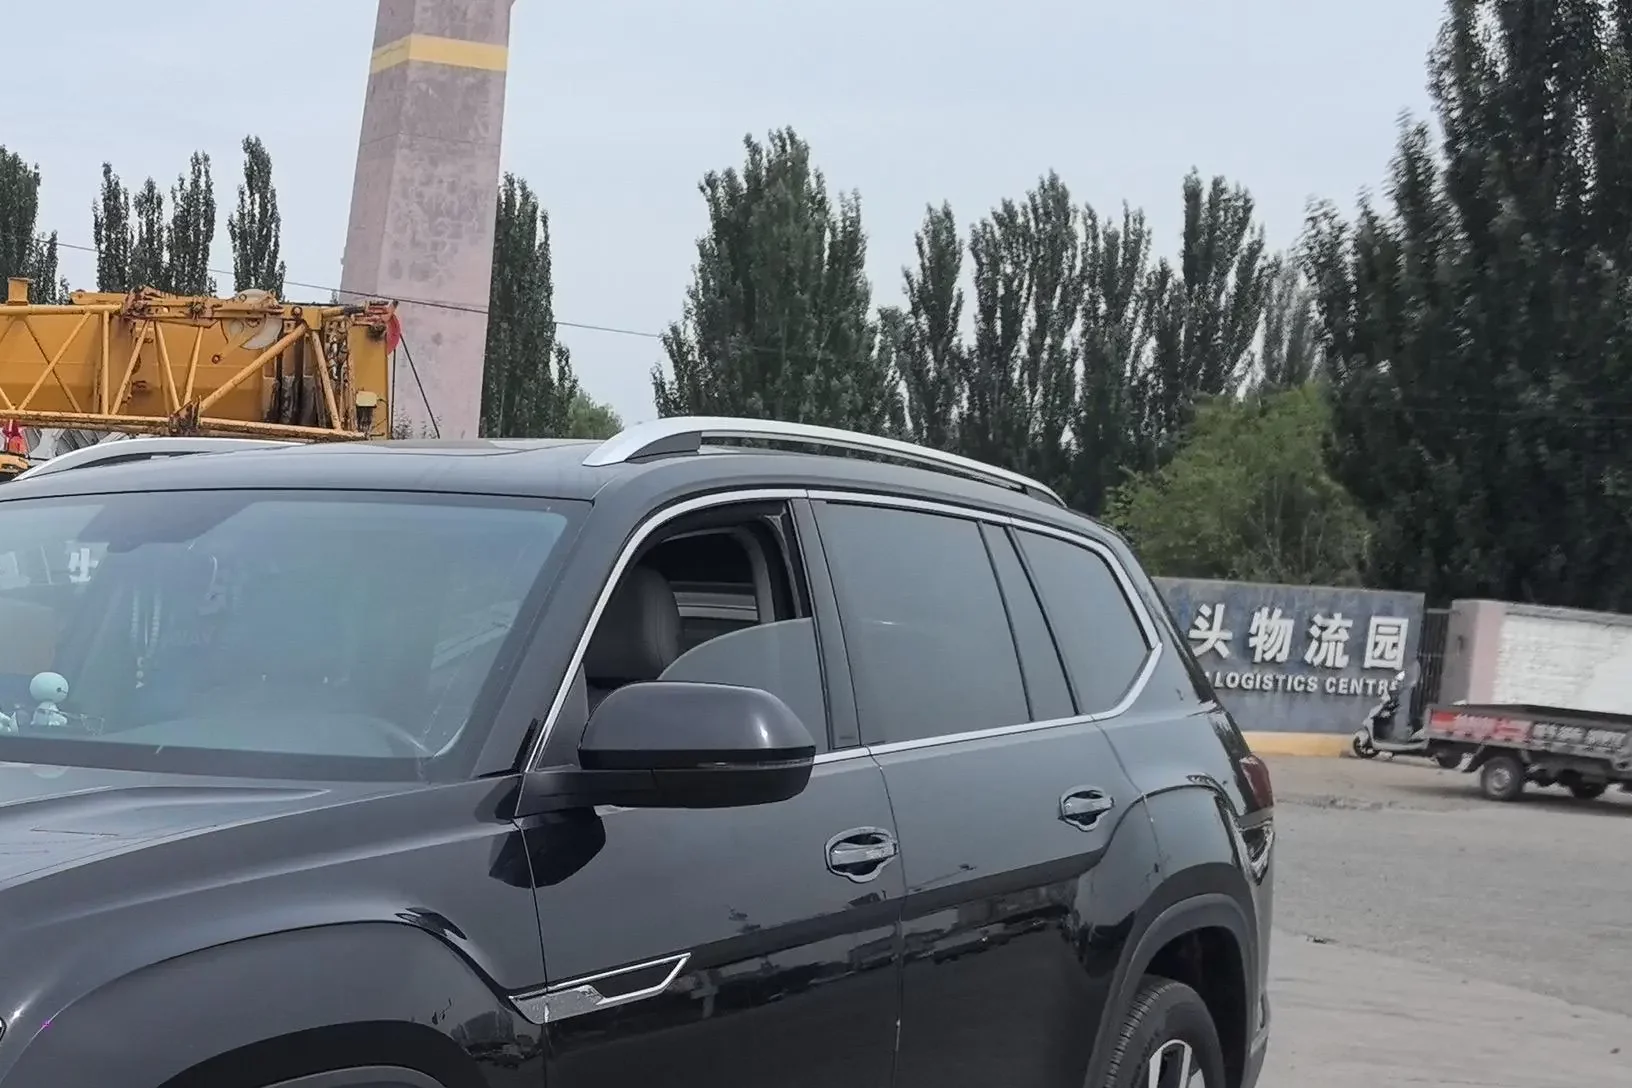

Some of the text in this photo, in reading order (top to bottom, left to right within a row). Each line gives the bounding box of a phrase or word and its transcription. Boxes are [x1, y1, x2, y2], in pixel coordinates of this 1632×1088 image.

[1188, 603, 1409, 671] 头物流园
[1214, 671, 1317, 694] LOGISTICS
